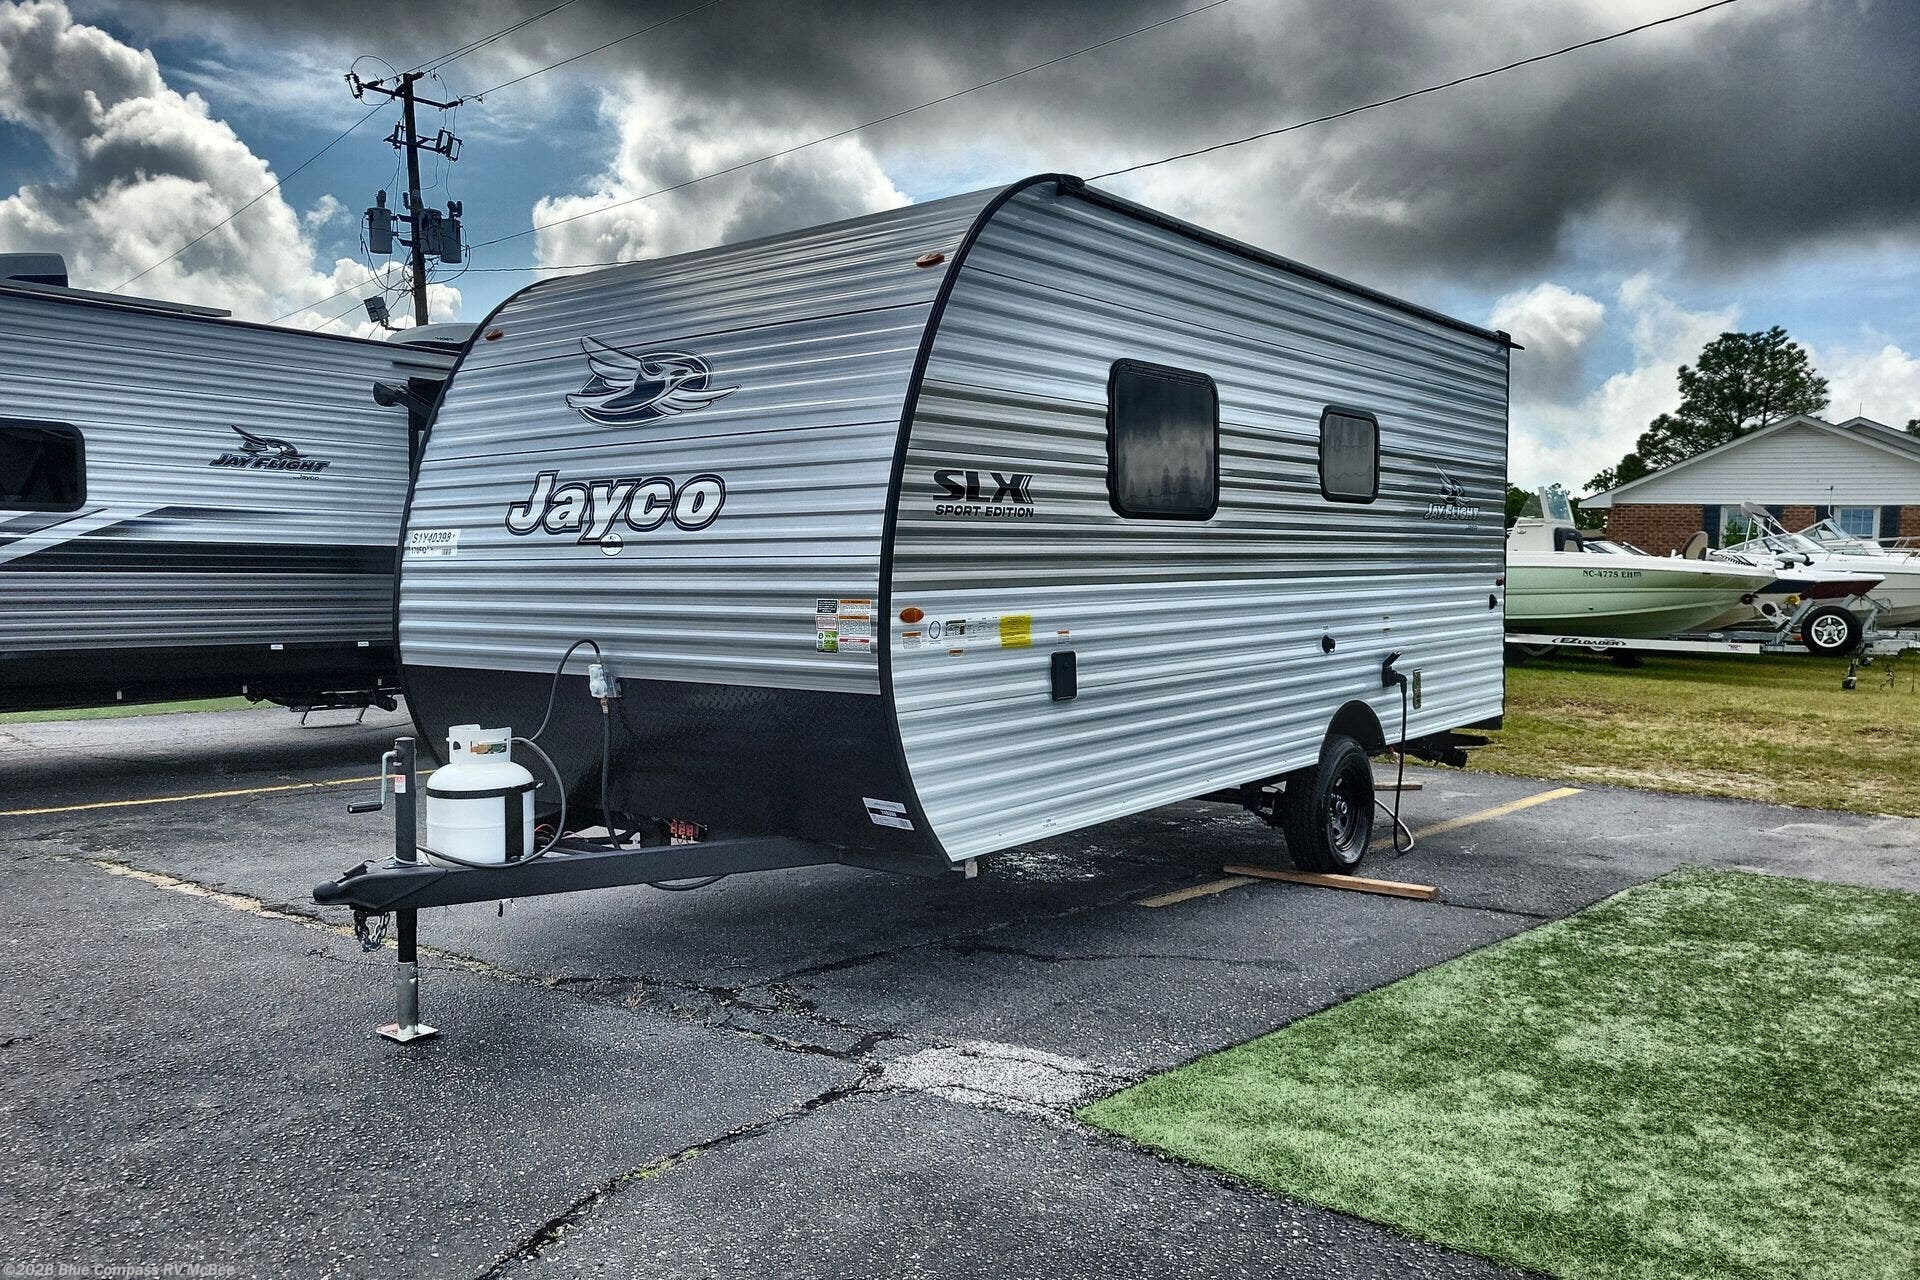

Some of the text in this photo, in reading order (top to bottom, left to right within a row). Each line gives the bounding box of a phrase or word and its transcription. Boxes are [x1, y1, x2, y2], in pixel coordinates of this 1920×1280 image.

[208, 453, 331, 472] JAY FLIGHT
[932, 469, 1034, 504] SLX
[505, 469, 727, 545] Jayco
[935, 505, 1034, 517] SPORT EDITION
[1423, 502, 1480, 520] JAY FLIGHT
